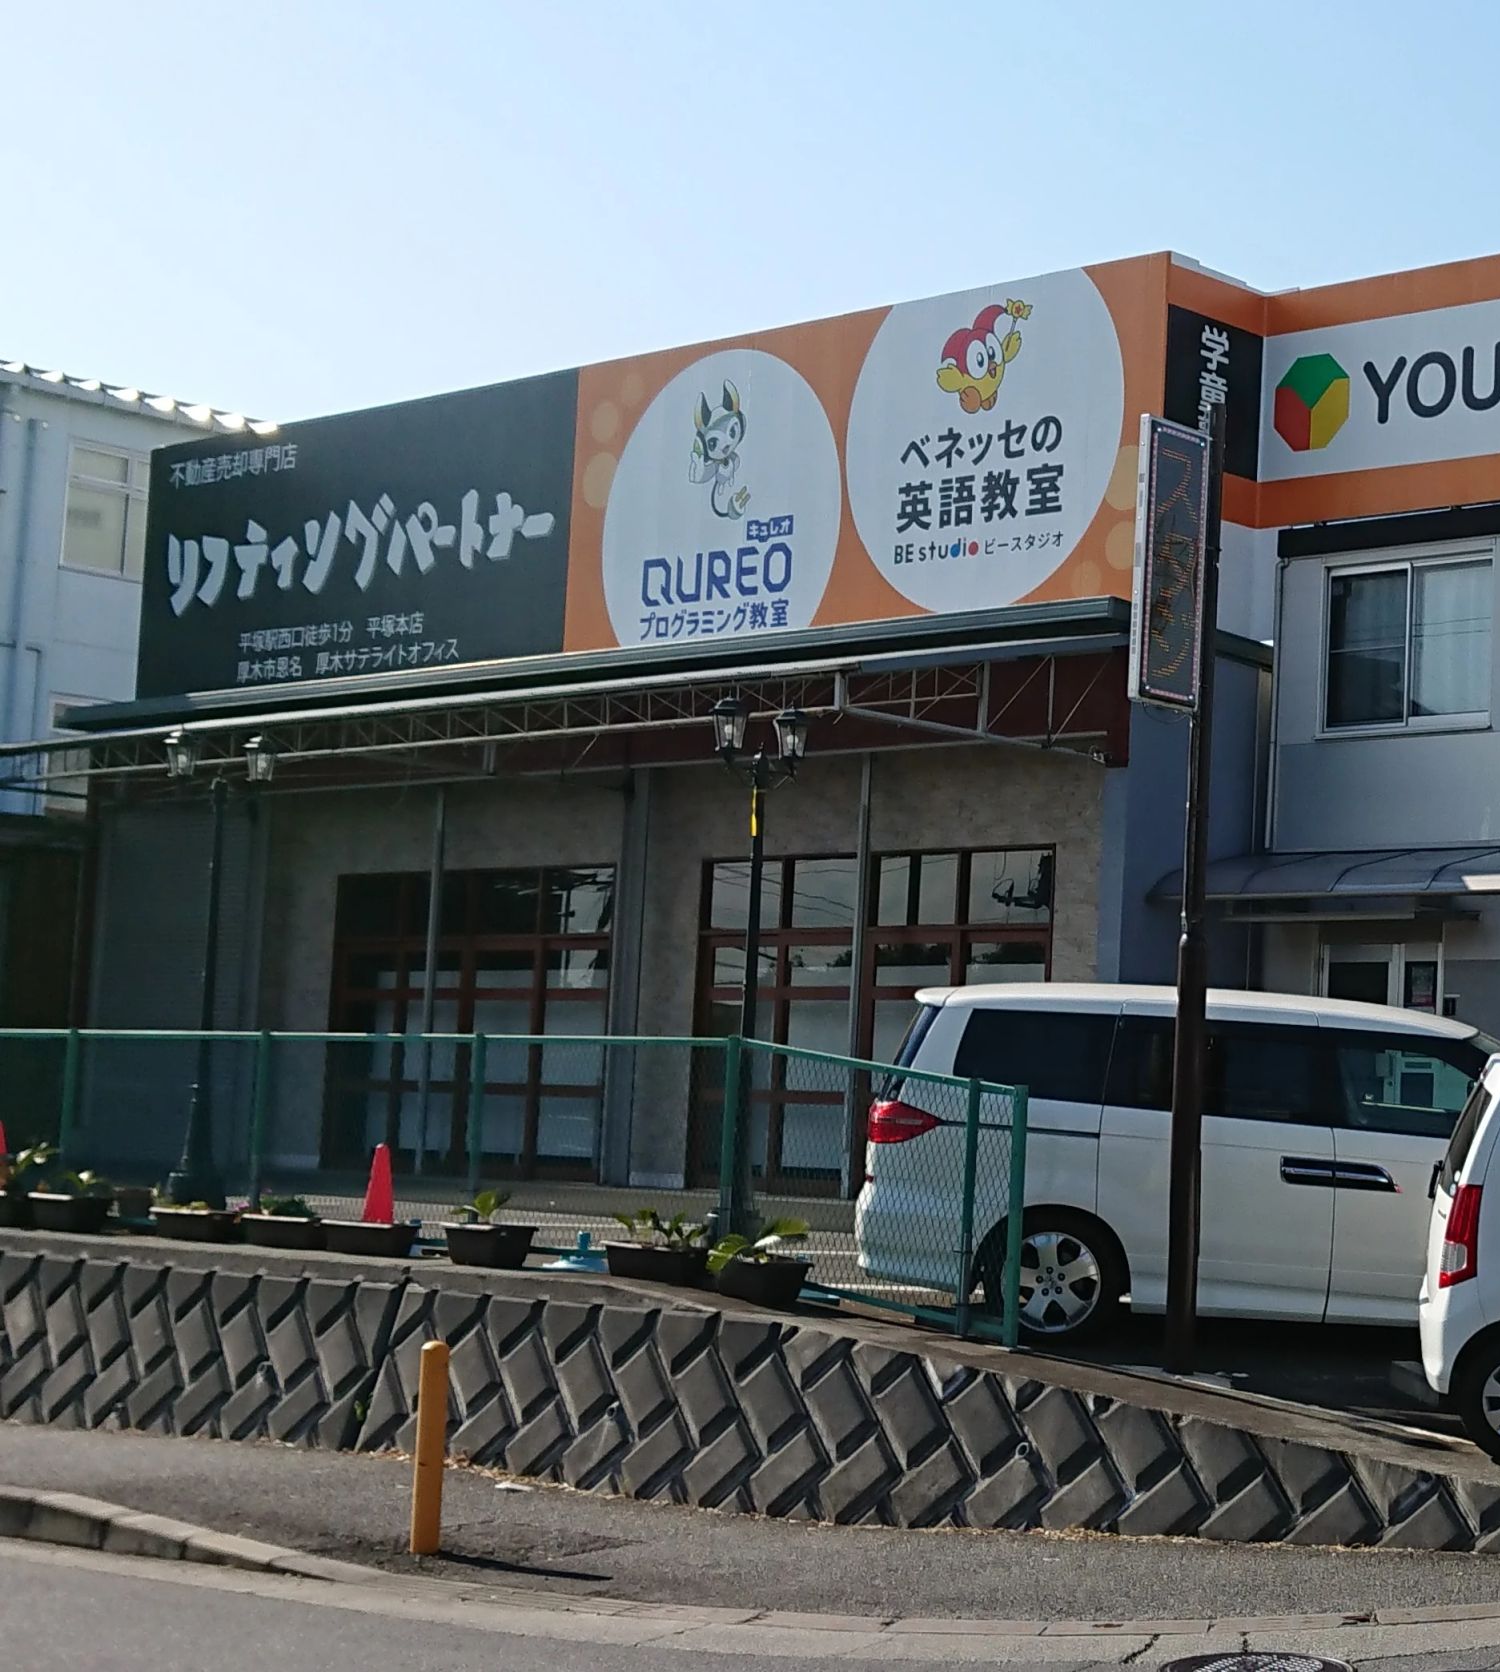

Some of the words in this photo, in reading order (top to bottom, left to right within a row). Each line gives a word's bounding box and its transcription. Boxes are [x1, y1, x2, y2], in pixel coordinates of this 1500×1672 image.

[900, 415, 1063, 468] ベネッセの
[169, 443, 298, 489] 不動産売却専門店
[896, 463, 1064, 534] 英語教室
[749, 519, 791, 537] キュレオ
[894, 544, 914, 565] BE
[918, 537, 979, 562] studio
[985, 531, 1064, 554] ビースタジオ
[168, 489, 555, 617] リフティングパートナー
[641, 542, 793, 608] QUREO
[238, 621, 353, 653] 平塚駅西口徒歩1分
[366, 611, 425, 639] 平塚本店
[640, 598, 789, 640] プログラミング教室
[316, 639, 460, 674] 厚木サテライトオフィス
